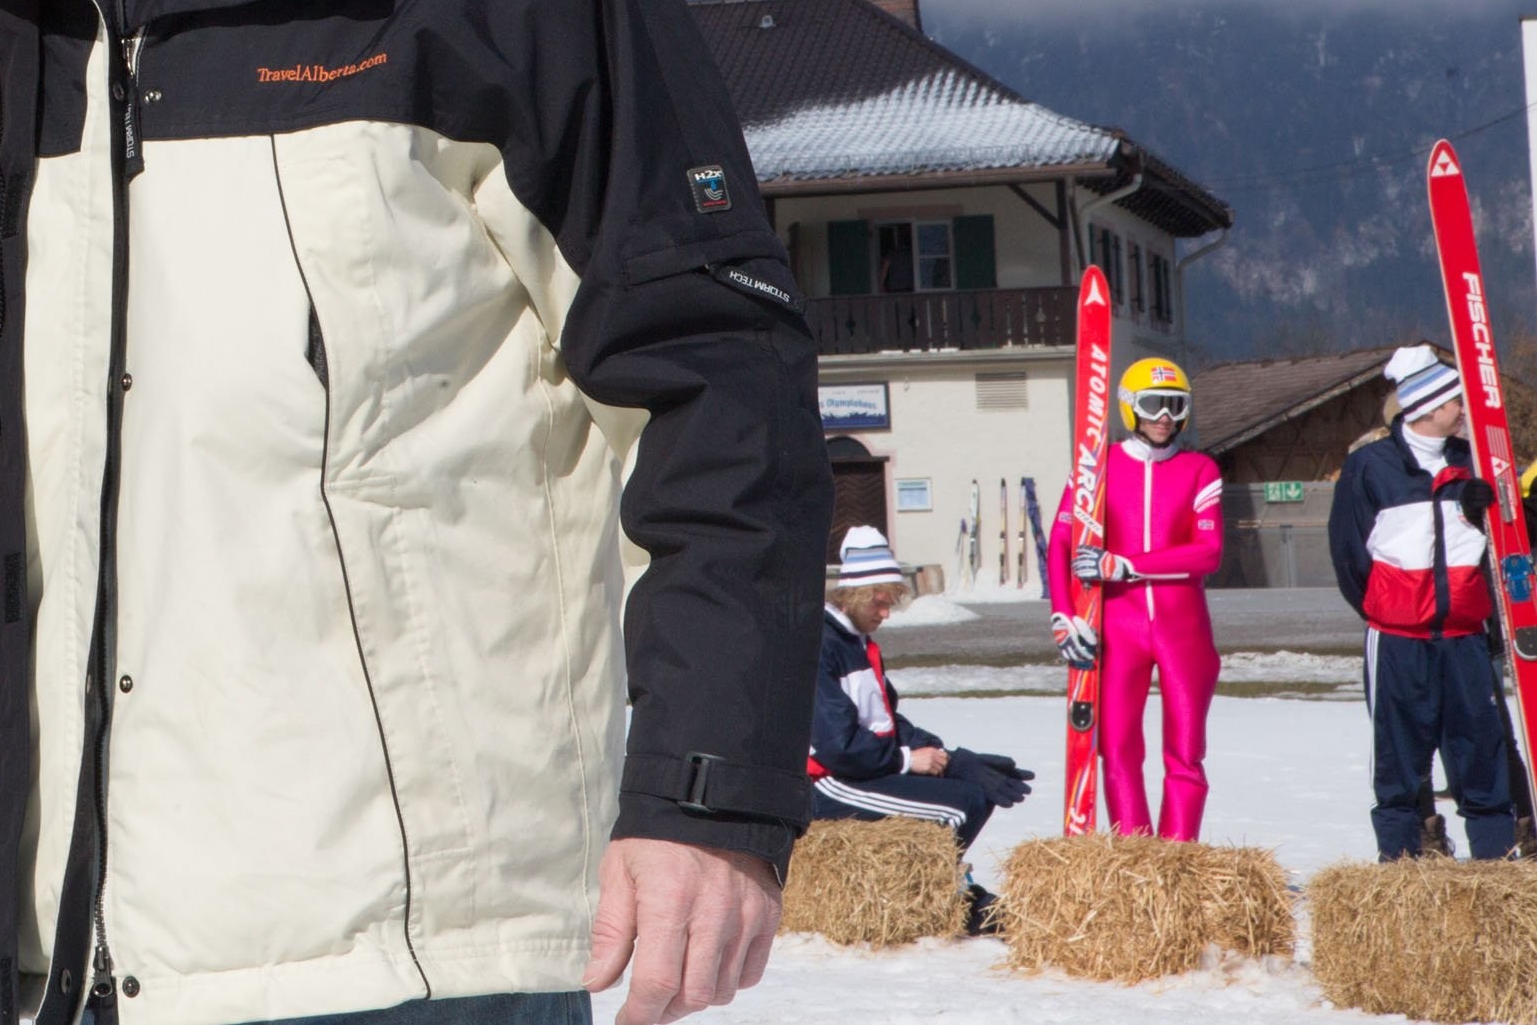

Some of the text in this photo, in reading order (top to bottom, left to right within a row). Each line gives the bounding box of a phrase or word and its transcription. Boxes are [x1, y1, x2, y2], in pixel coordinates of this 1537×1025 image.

[256, 51, 388, 82] TravelAlberta.com
[125, 125, 135, 159] STORM
[1462, 271, 1502, 410] FISCHER
[1075, 342, 1108, 514] ATOMIC ARC
